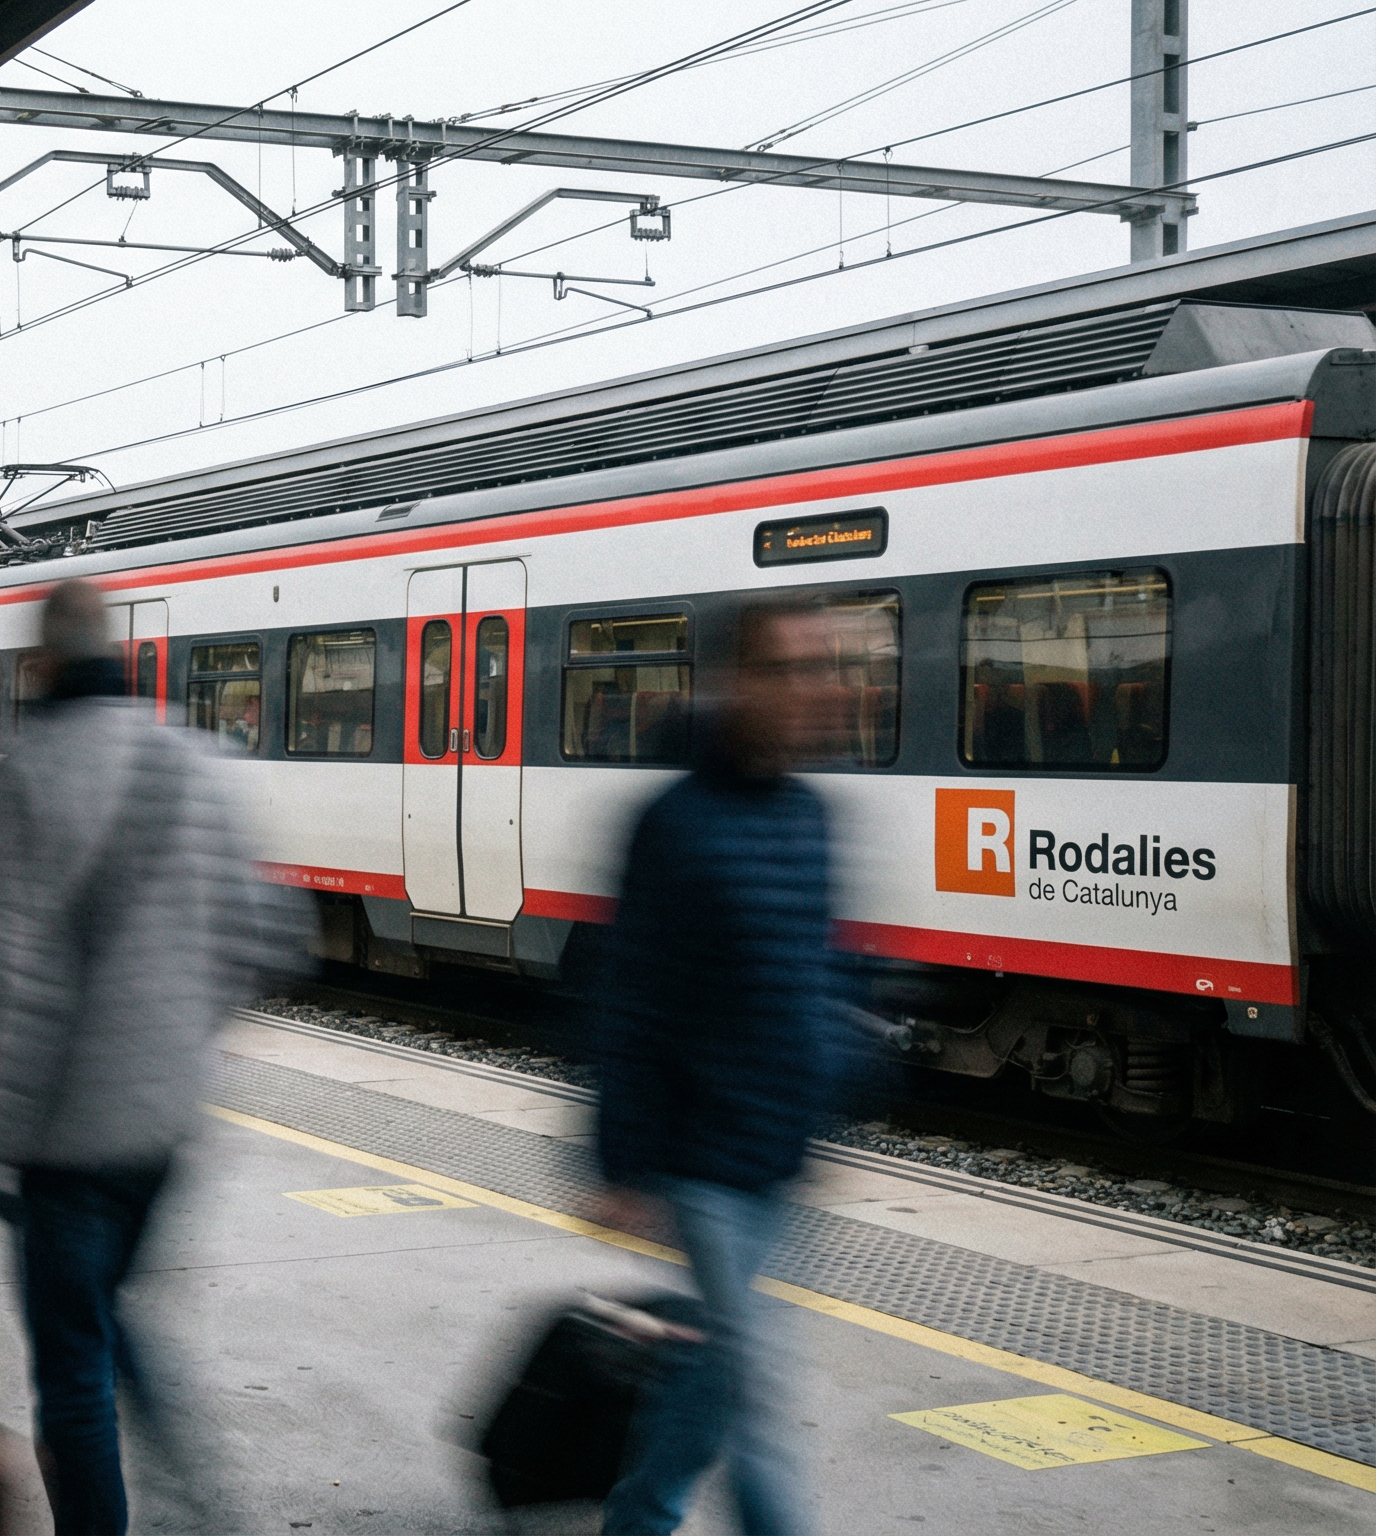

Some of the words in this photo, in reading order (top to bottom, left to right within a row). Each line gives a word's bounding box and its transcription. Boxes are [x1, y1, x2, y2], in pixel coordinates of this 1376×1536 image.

[967, 807, 1011, 873] R
[1028, 829, 1217, 881] Rodalies
[1028, 877, 1055, 901] de
[1062, 879, 1178, 917] Catalunya
